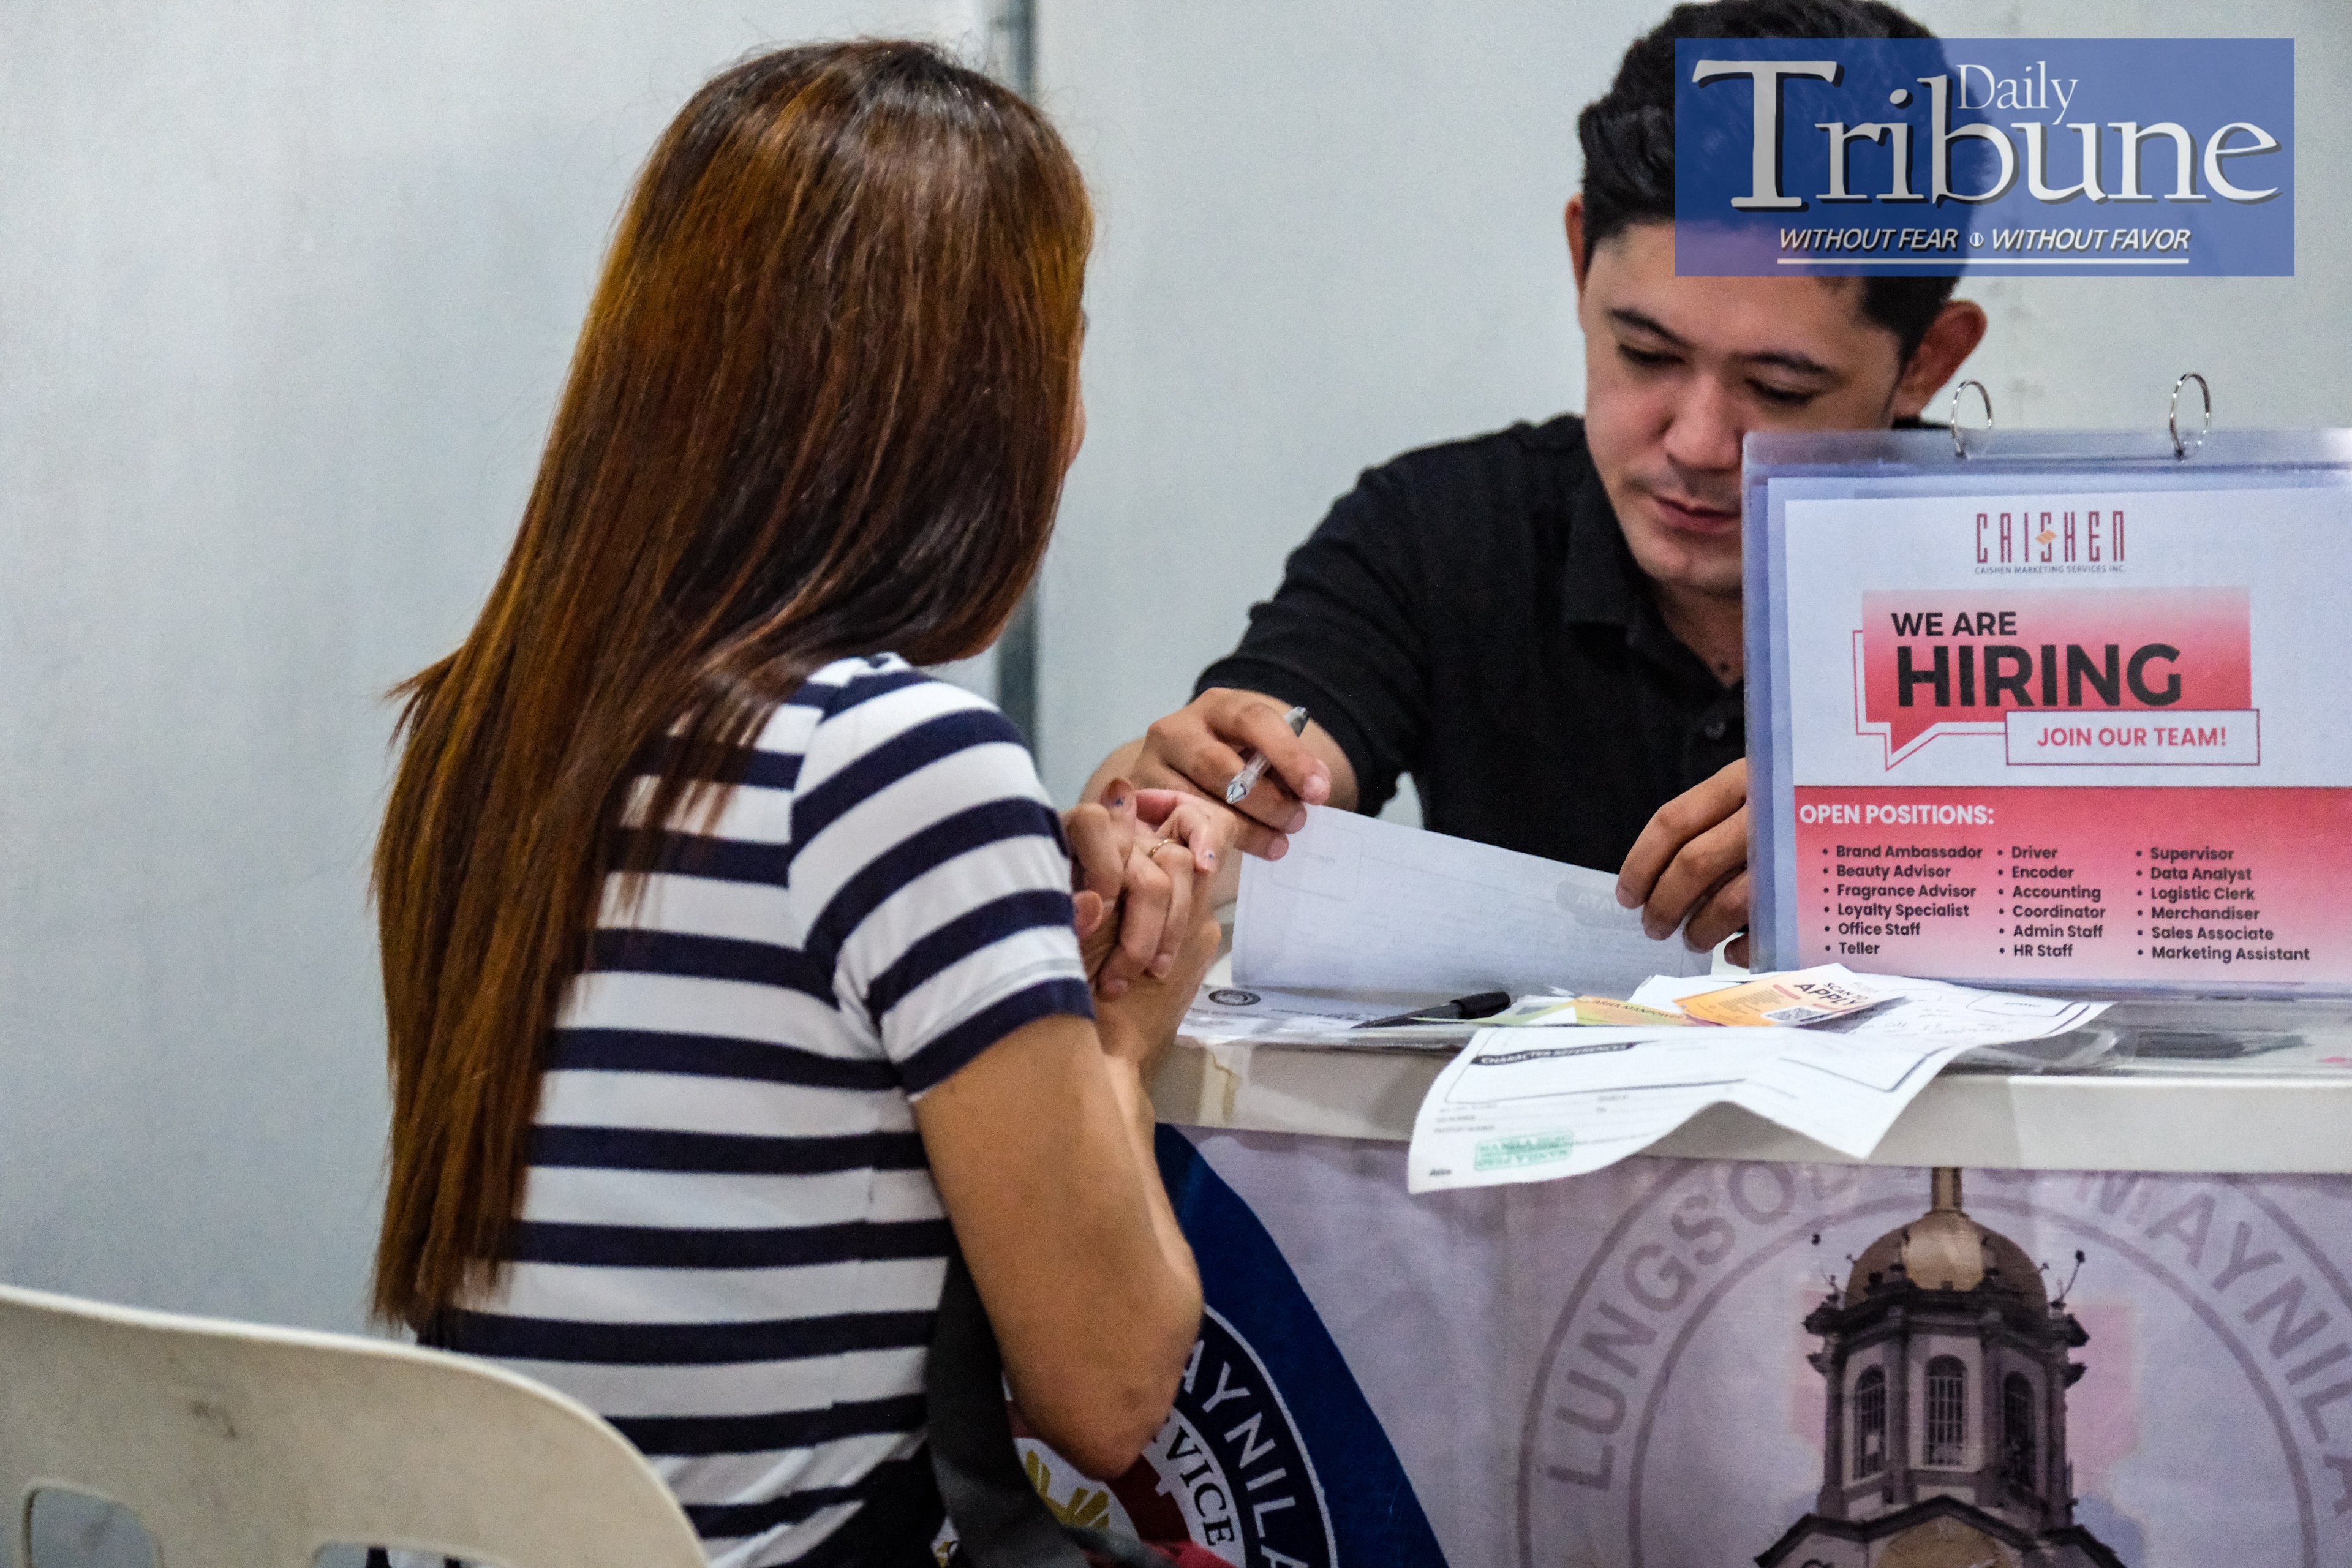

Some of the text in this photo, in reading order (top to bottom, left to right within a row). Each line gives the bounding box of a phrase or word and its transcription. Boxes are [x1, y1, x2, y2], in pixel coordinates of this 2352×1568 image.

[1976, 511, 2125, 564] CAISHEN
[1974, 566, 2012, 575] CAISHEN
[2014, 565, 2064, 574] MARKETING
[1891, 612, 2018, 636] WE ARE
[1897, 643, 2182, 708] HIRING
[2037, 727, 2226, 747] JOIN OUR TEAM!
[1800, 804, 1994, 824] OPEN POSITIONS:
[1836, 845, 1983, 859] Brand Ambassador
[2011, 845, 2058, 858] Driver
[2150, 846, 2234, 864] Supervisor
[1837, 864, 1951, 881] Beauty Advisor
[2012, 865, 2075, 878] Encoder
[2150, 867, 2252, 884] Data Analyst
[1838, 884, 1977, 900] Fragrance Advisor
[2013, 885, 2101, 903] Accounting
[2151, 886, 2255, 903] Logistic Clerk
[1838, 903, 1969, 920] Loyalty Specialist
[2013, 905, 2106, 919] Coordinator
[2152, 906, 2260, 920] Merchandiser
[1838, 922, 1921, 936] Office Staff
[2013, 924, 2103, 938] Admin Staff
[2152, 925, 2274, 940] Sales Associate
[1839, 941, 1880, 954] Teller
[2014, 944, 2073, 957] HR Staff
[2152, 946, 2310, 963] Marketing Assistant
[1793, 984, 1863, 1006] APPLY
[1154, 1415, 1235, 1547] VICE
